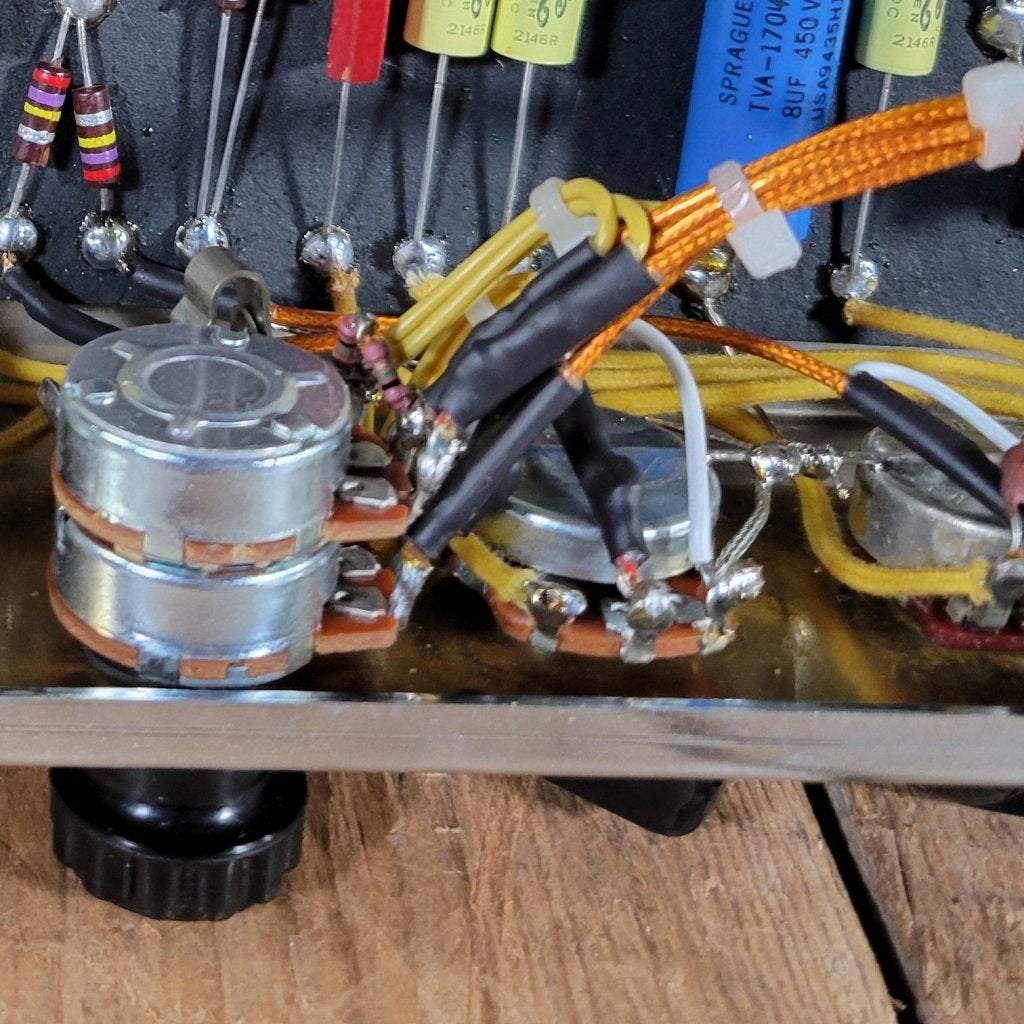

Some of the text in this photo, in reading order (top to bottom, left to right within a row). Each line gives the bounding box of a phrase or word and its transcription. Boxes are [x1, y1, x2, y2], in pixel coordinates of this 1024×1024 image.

[513, 29, 559, 47] 2146R
[719, 0, 754, 106] SPRAGUE
[782, 76, 808, 119] 8UF
